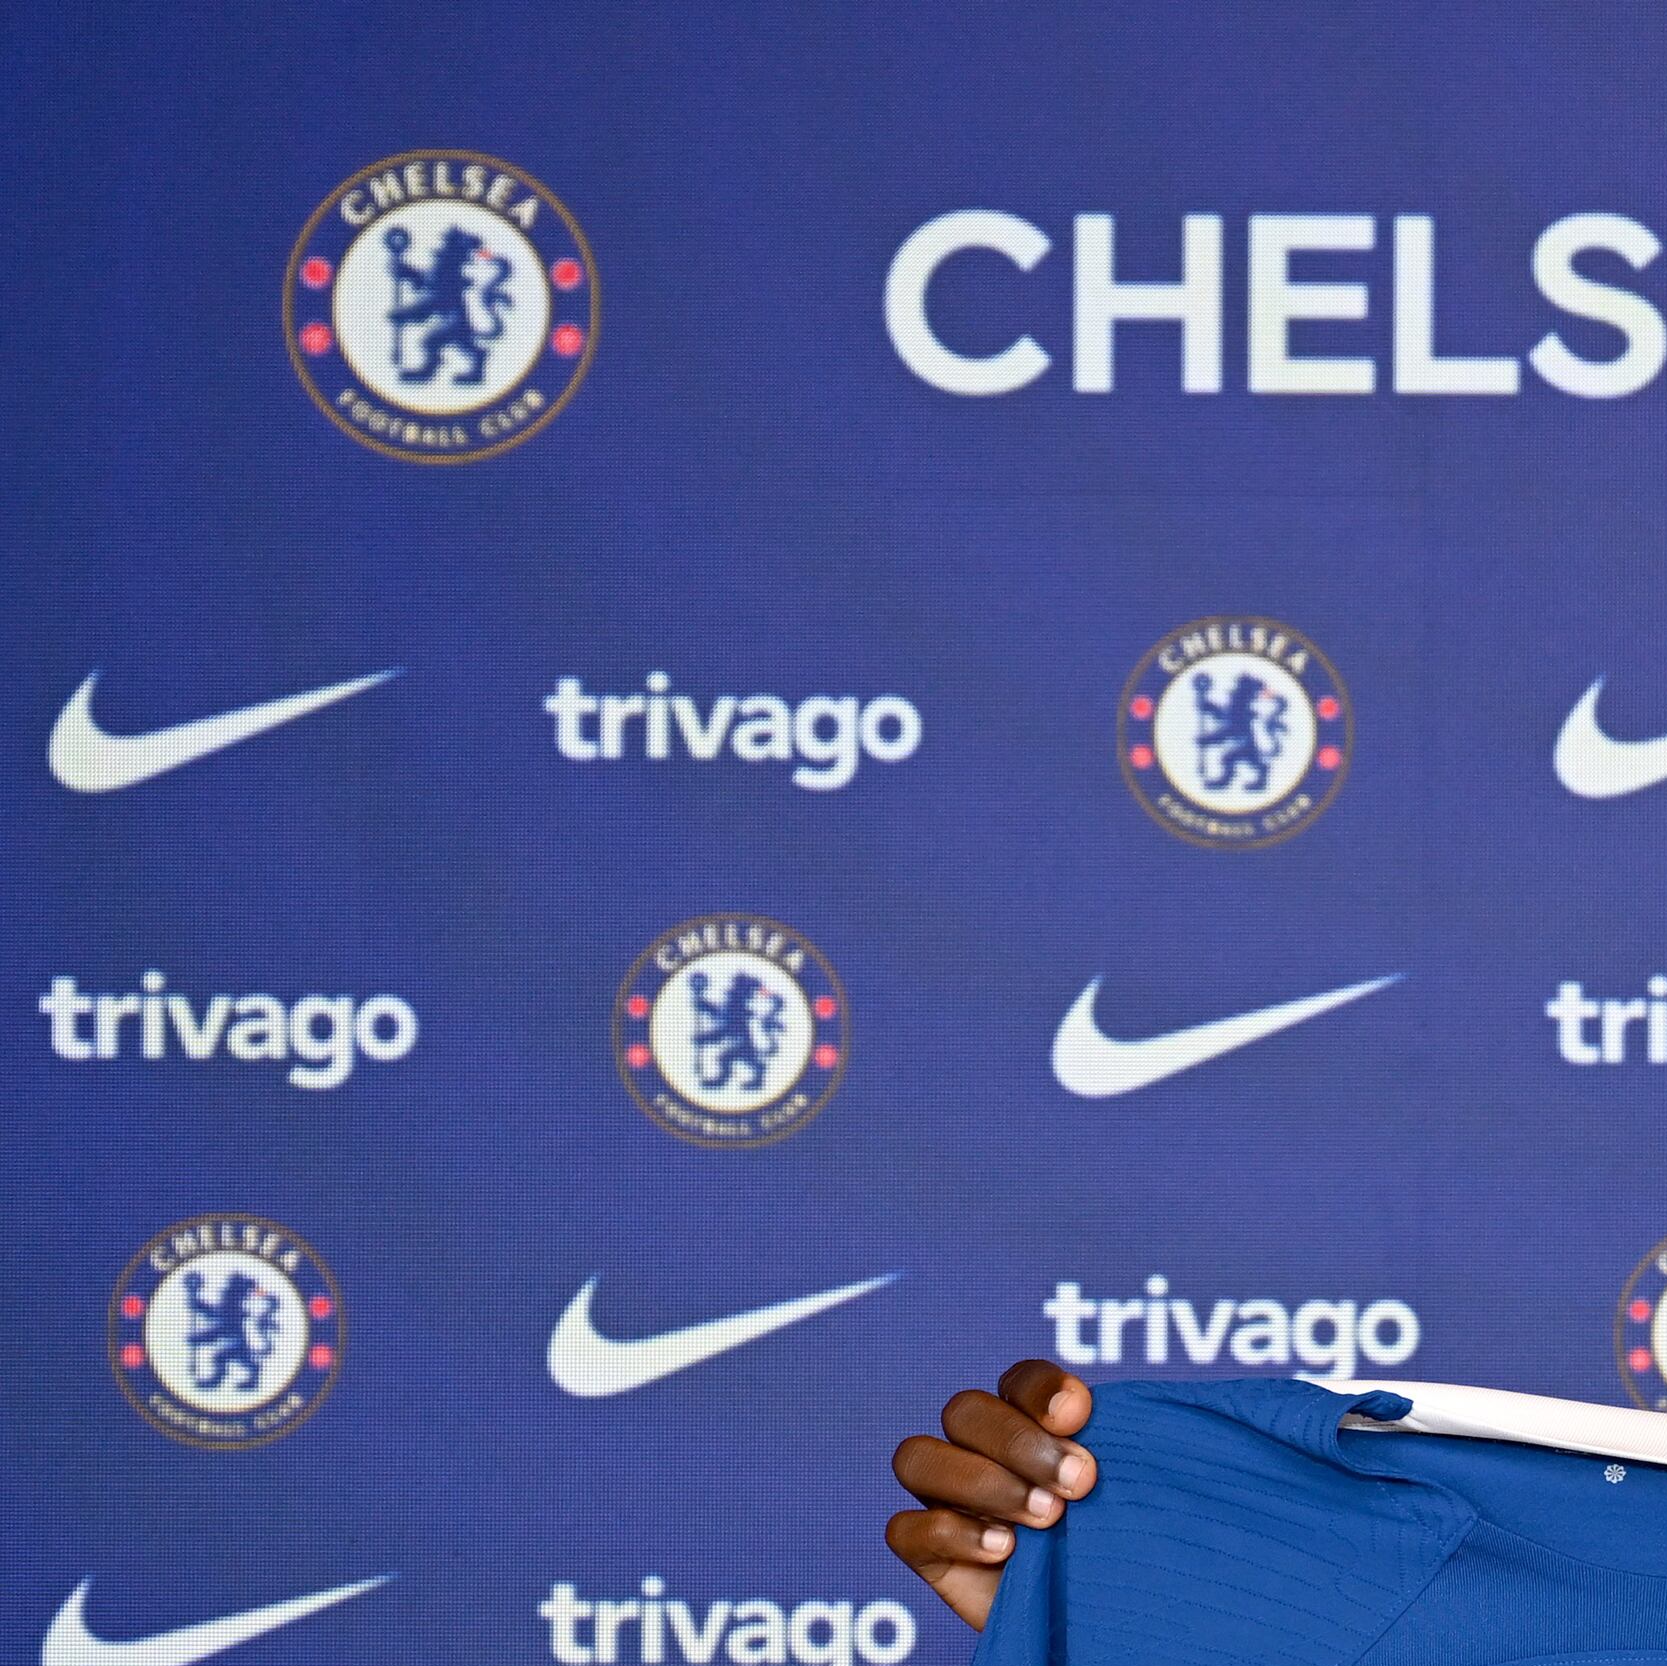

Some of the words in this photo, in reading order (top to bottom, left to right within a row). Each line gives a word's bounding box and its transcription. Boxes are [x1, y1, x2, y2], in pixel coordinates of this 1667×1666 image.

[339, 161, 539, 229] CHELSEA
[337, 389, 464, 445] FOOTBALL
[477, 388, 545, 438] CLUB
[1157, 623, 1308, 674] CHELSEA
[546, 673, 921, 790] trivago
[654, 922, 805, 973] CHELSEA
[41, 973, 416, 1089] trivago
[149, 1222, 299, 1273] CHELSEA
[1043, 1273, 1421, 1381] trivago
